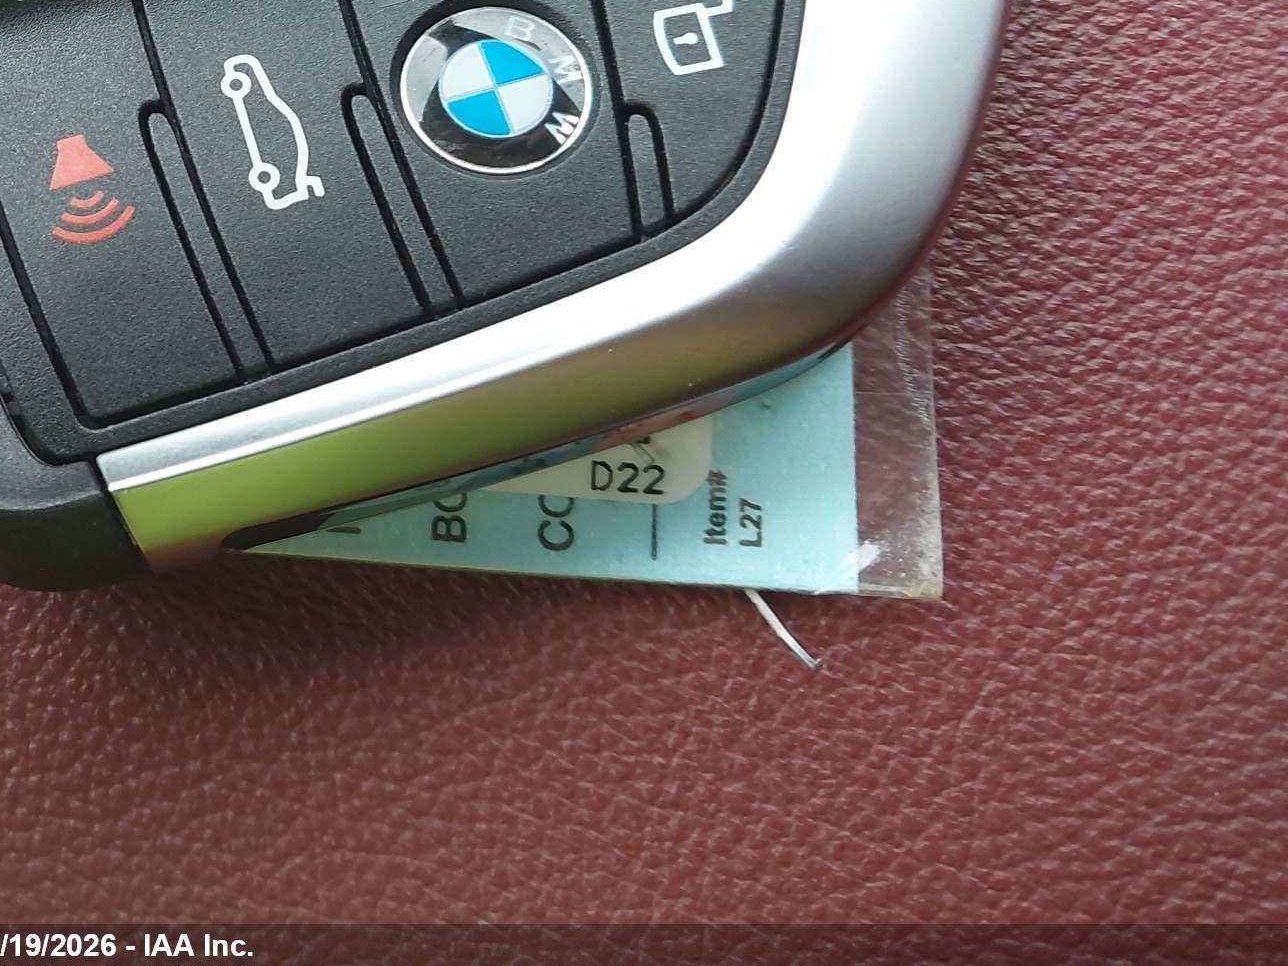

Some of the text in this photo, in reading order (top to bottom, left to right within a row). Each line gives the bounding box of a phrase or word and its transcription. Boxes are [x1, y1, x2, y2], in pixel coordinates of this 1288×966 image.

[590, 460, 665, 495] D22
[704, 468, 729, 545] Item#
[739, 498, 762, 547] L27
